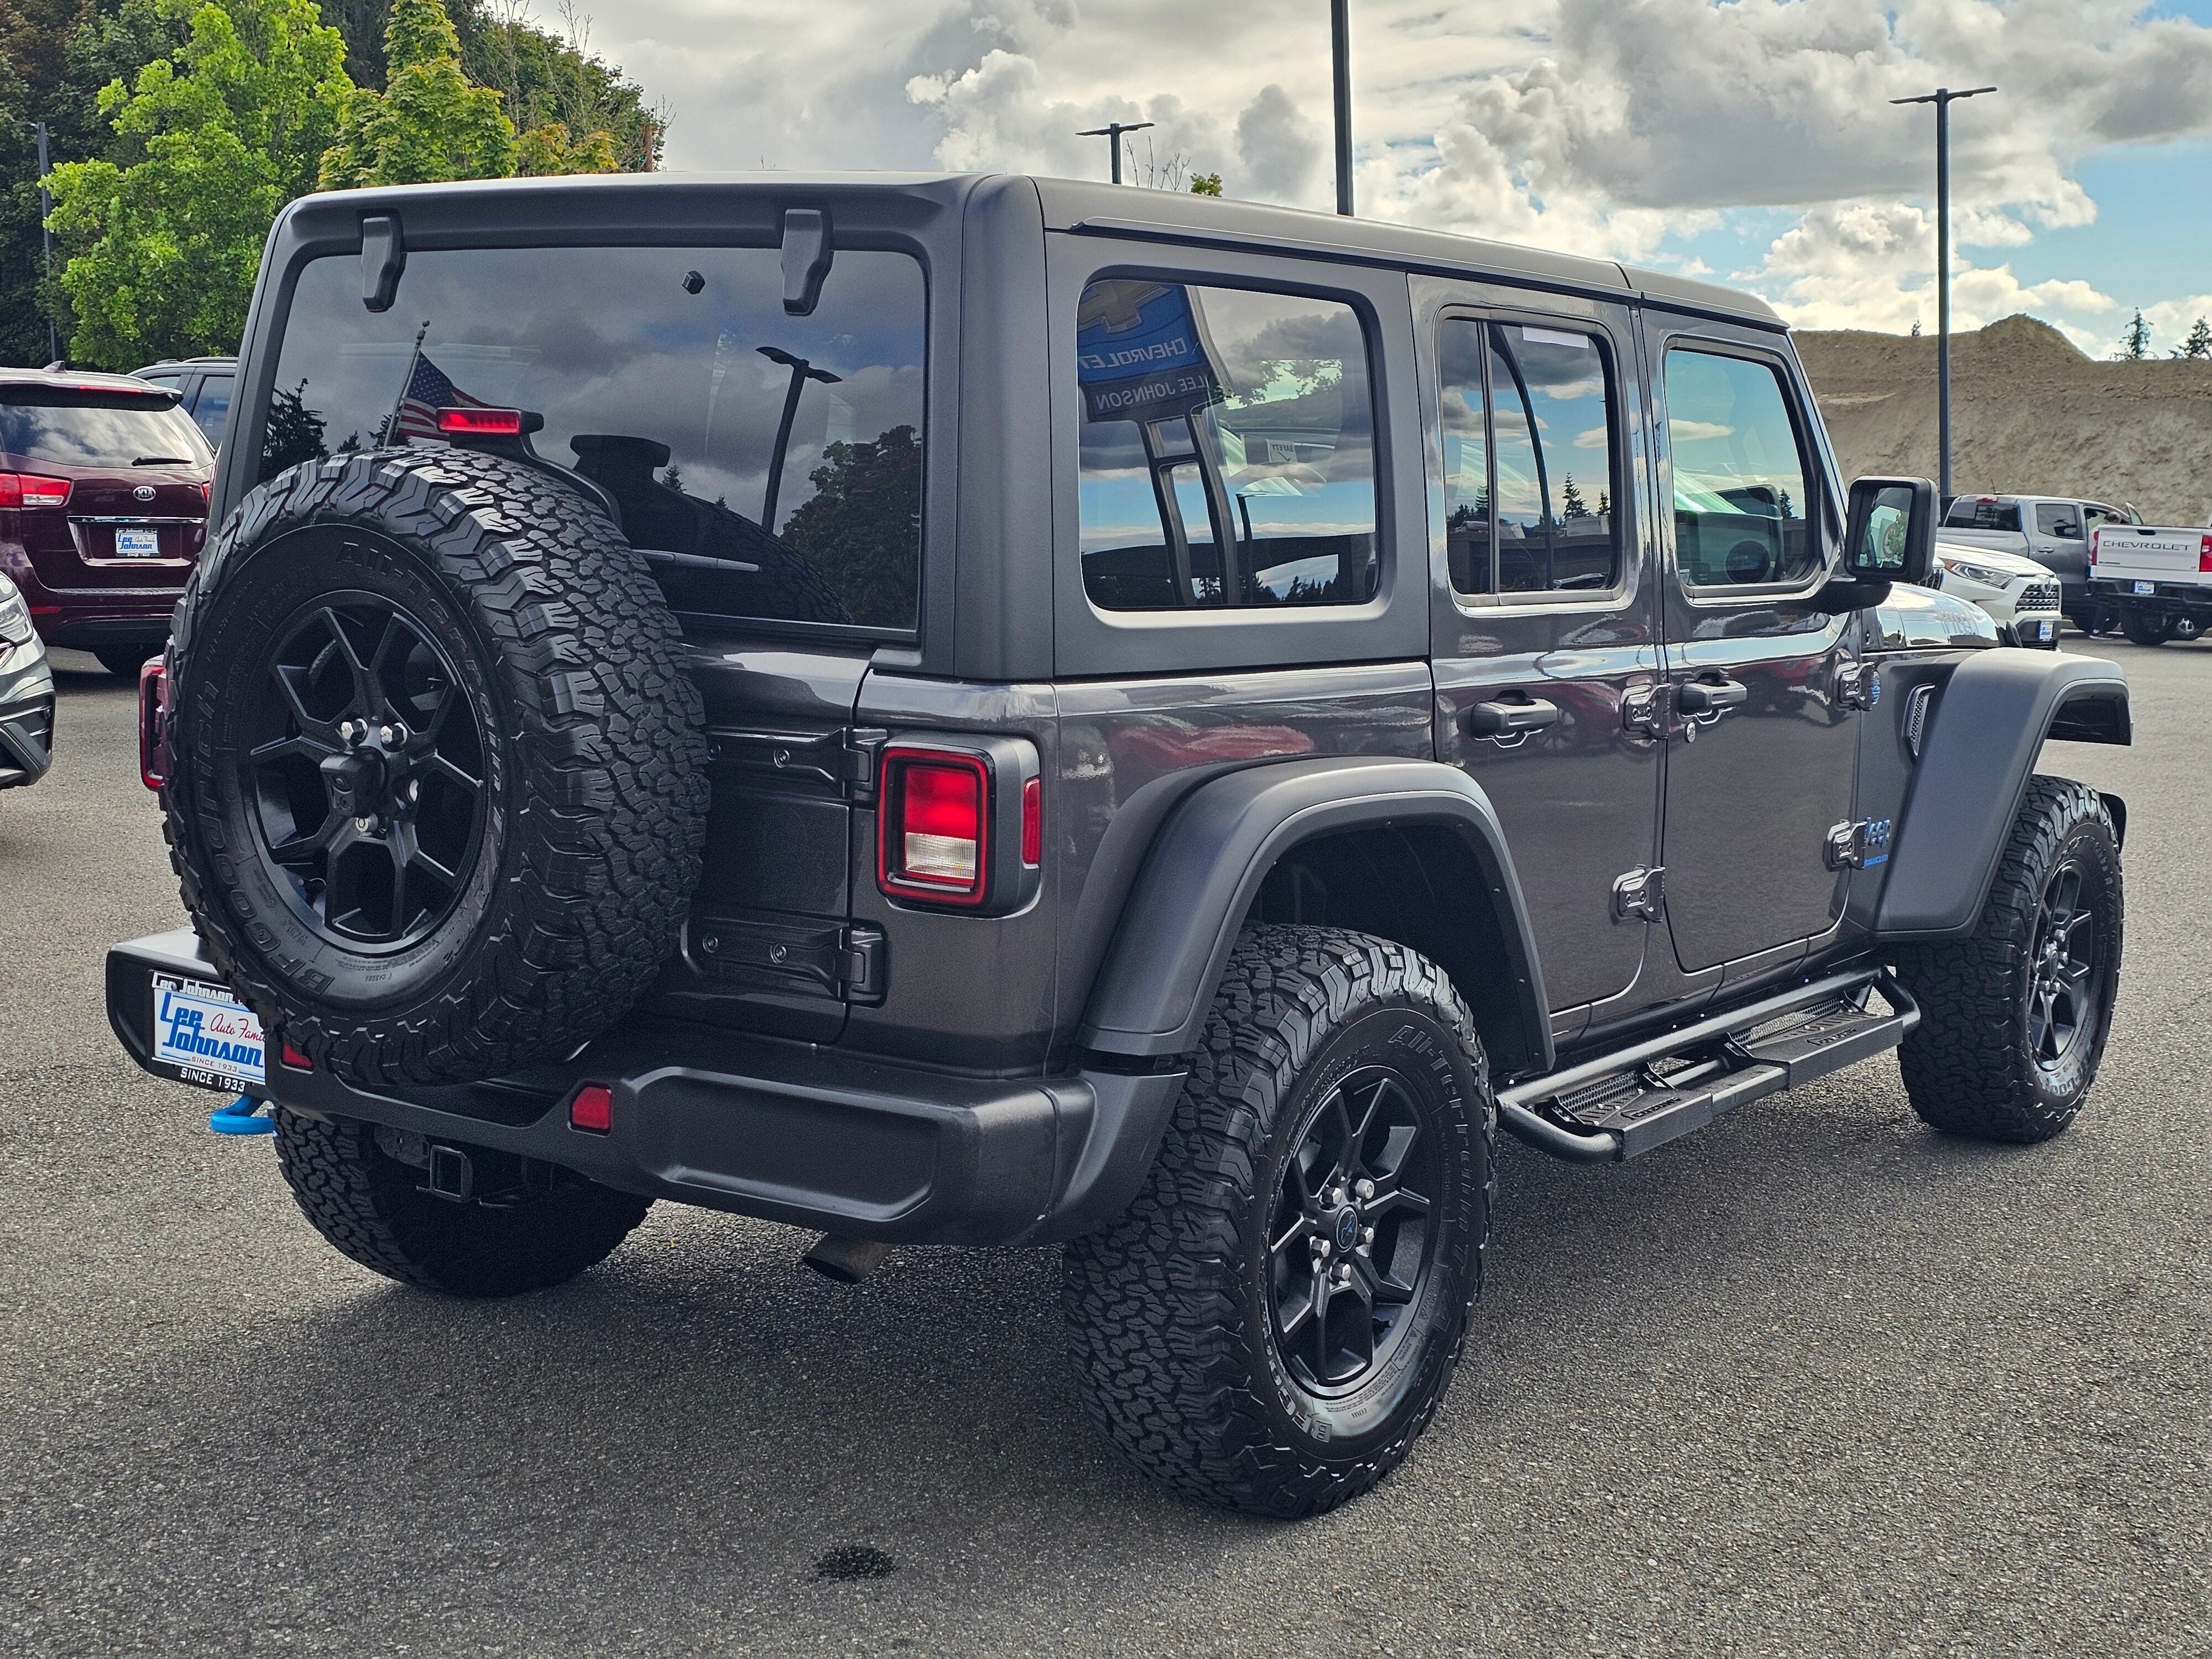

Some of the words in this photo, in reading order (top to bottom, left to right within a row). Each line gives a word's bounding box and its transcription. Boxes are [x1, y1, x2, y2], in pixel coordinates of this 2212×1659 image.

[138, 489, 153, 498] KIA
[118, 533, 133, 542] Lee
[119, 541, 153, 549] Johnson
[2103, 541, 2192, 551] CHEVROLET
[180, 978, 235, 1003] Johnson
[160, 992, 204, 1025] Lee
[210, 1013, 236, 1035] Auto
[162, 1023, 264, 1068] Johnson
[191, 1056, 215, 1067] SINCE
[218, 1062, 237, 1072] 1933
[180, 1068, 214, 1085] SINCE
[219, 1076, 246, 1093] 1933
